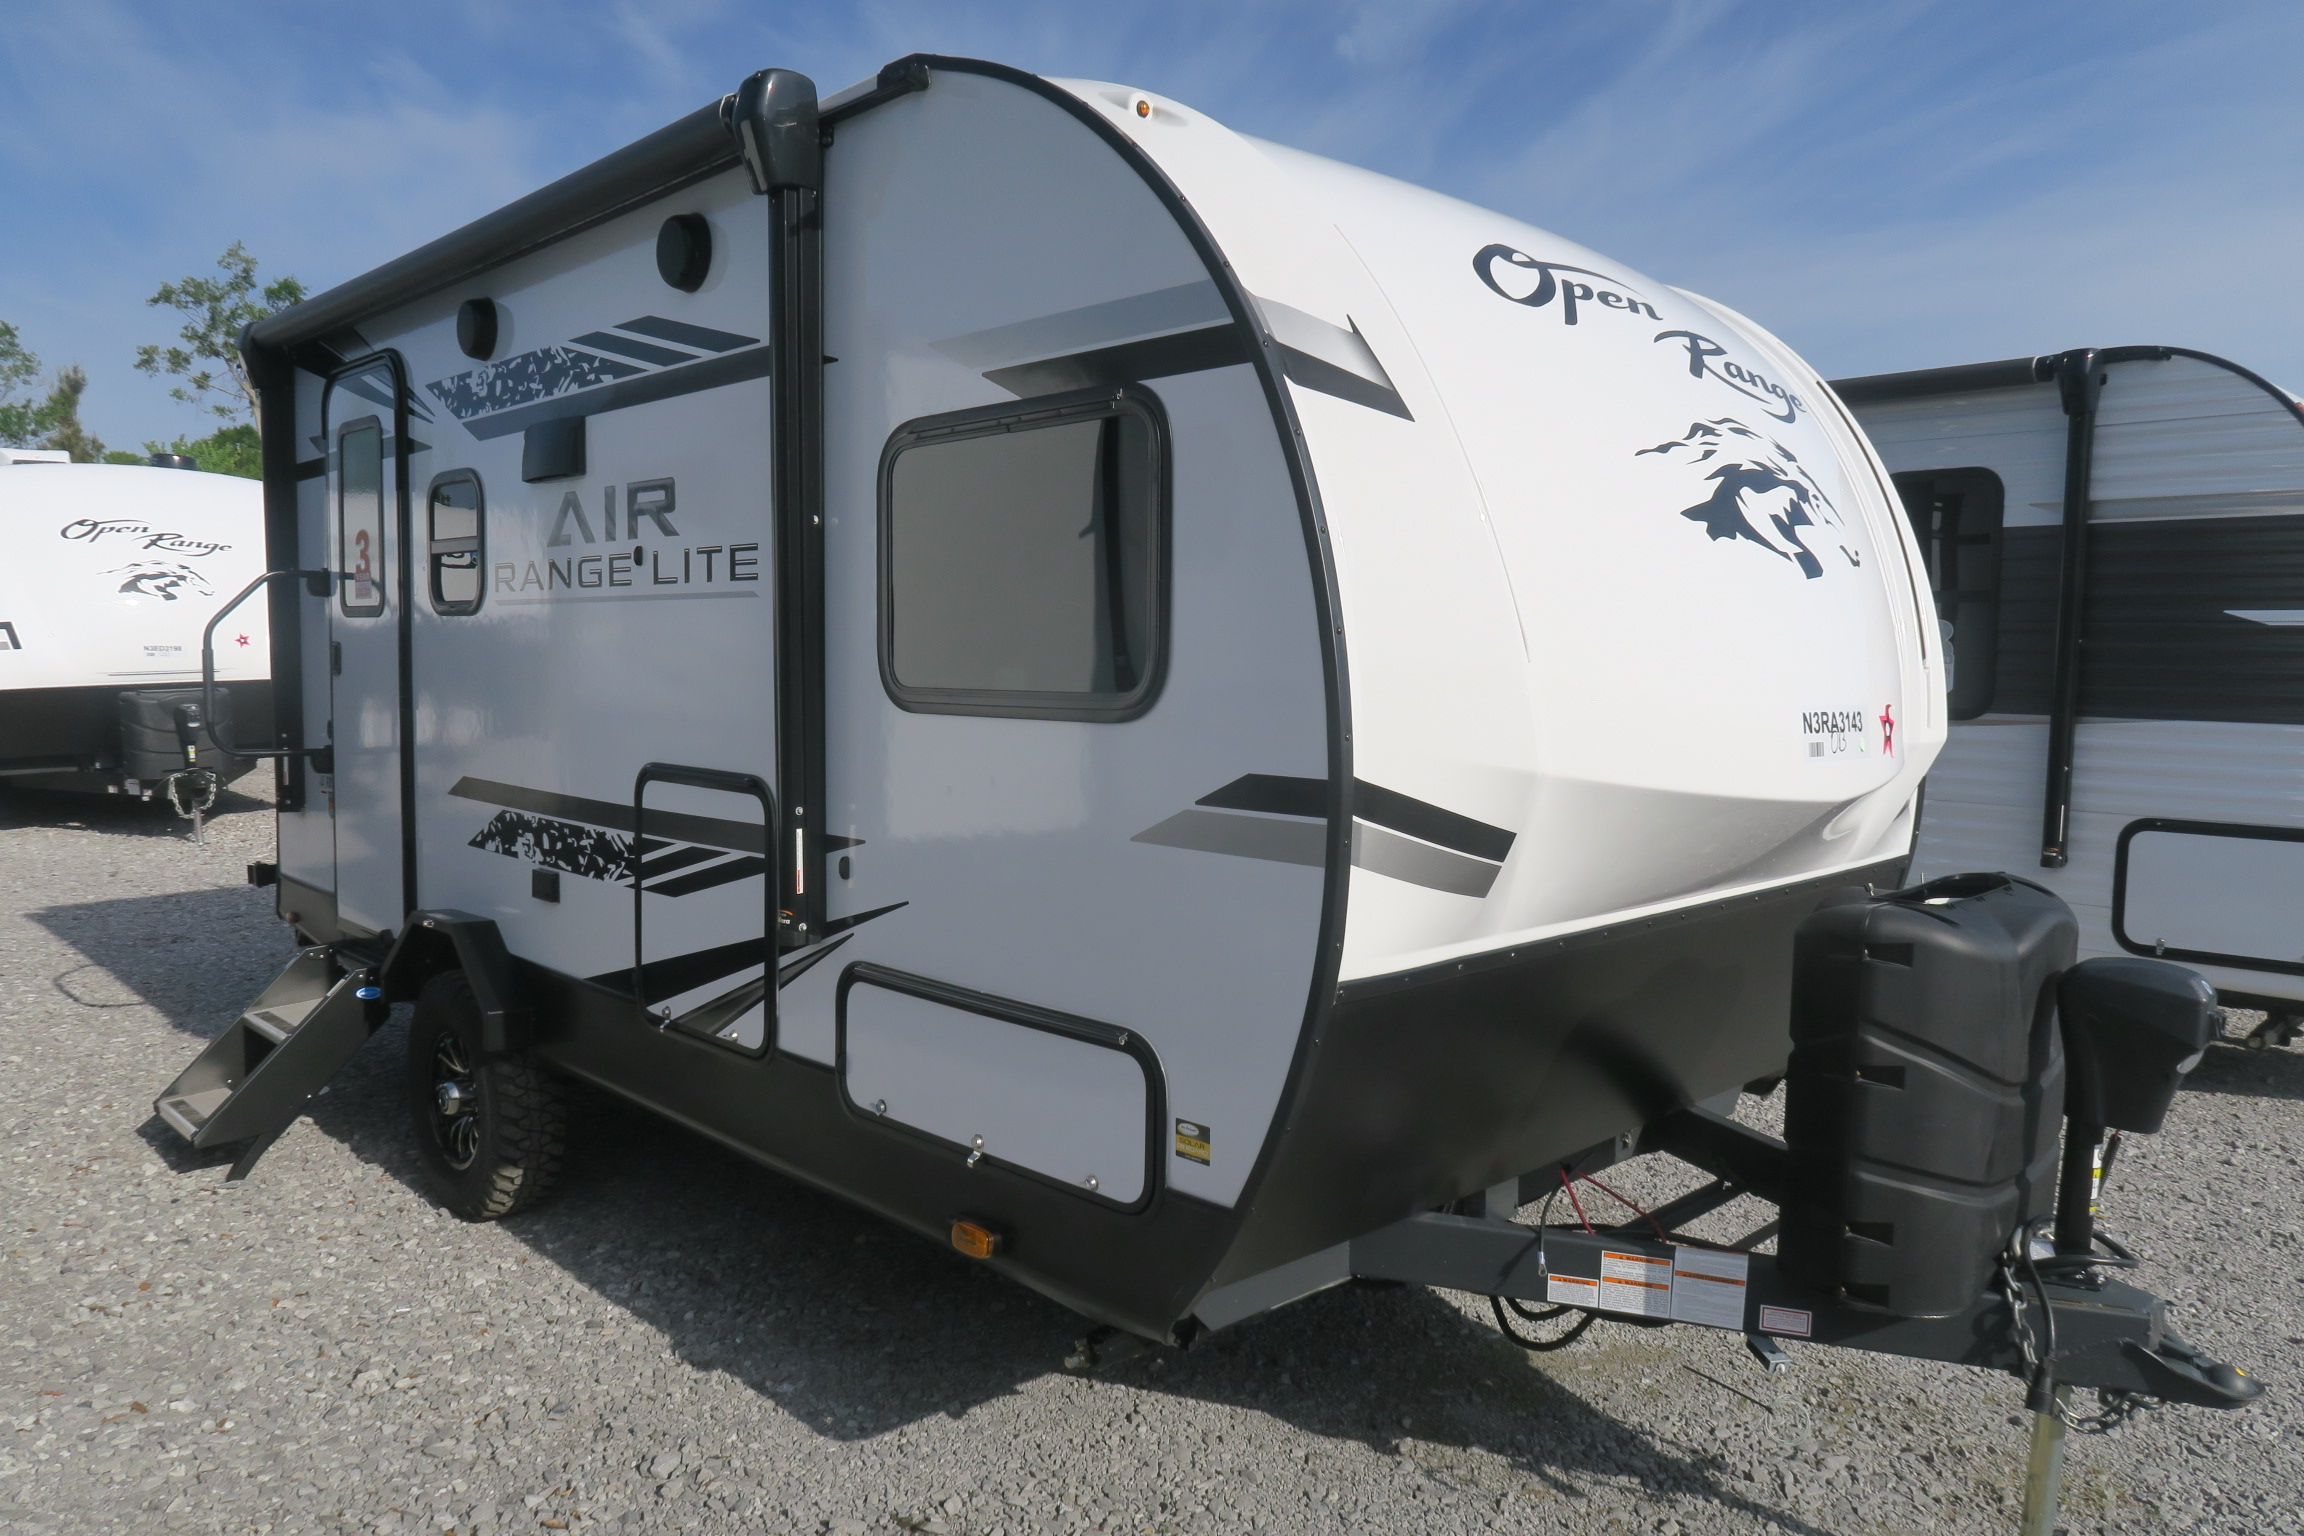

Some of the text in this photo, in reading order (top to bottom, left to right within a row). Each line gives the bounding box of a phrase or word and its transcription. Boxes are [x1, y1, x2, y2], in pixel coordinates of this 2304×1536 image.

[1472, 243, 1664, 326] Open
[1653, 329, 1808, 424] Range
[60, 518, 152, 543] Open
[546, 476, 681, 548] AIR
[131, 532, 233, 557] Range
[355, 528, 370, 573] 3
[494, 542, 759, 593] RANGE LITE
[1802, 711, 1863, 734] N3RA3143
[1179, 1137, 1205, 1150] SOLAR
